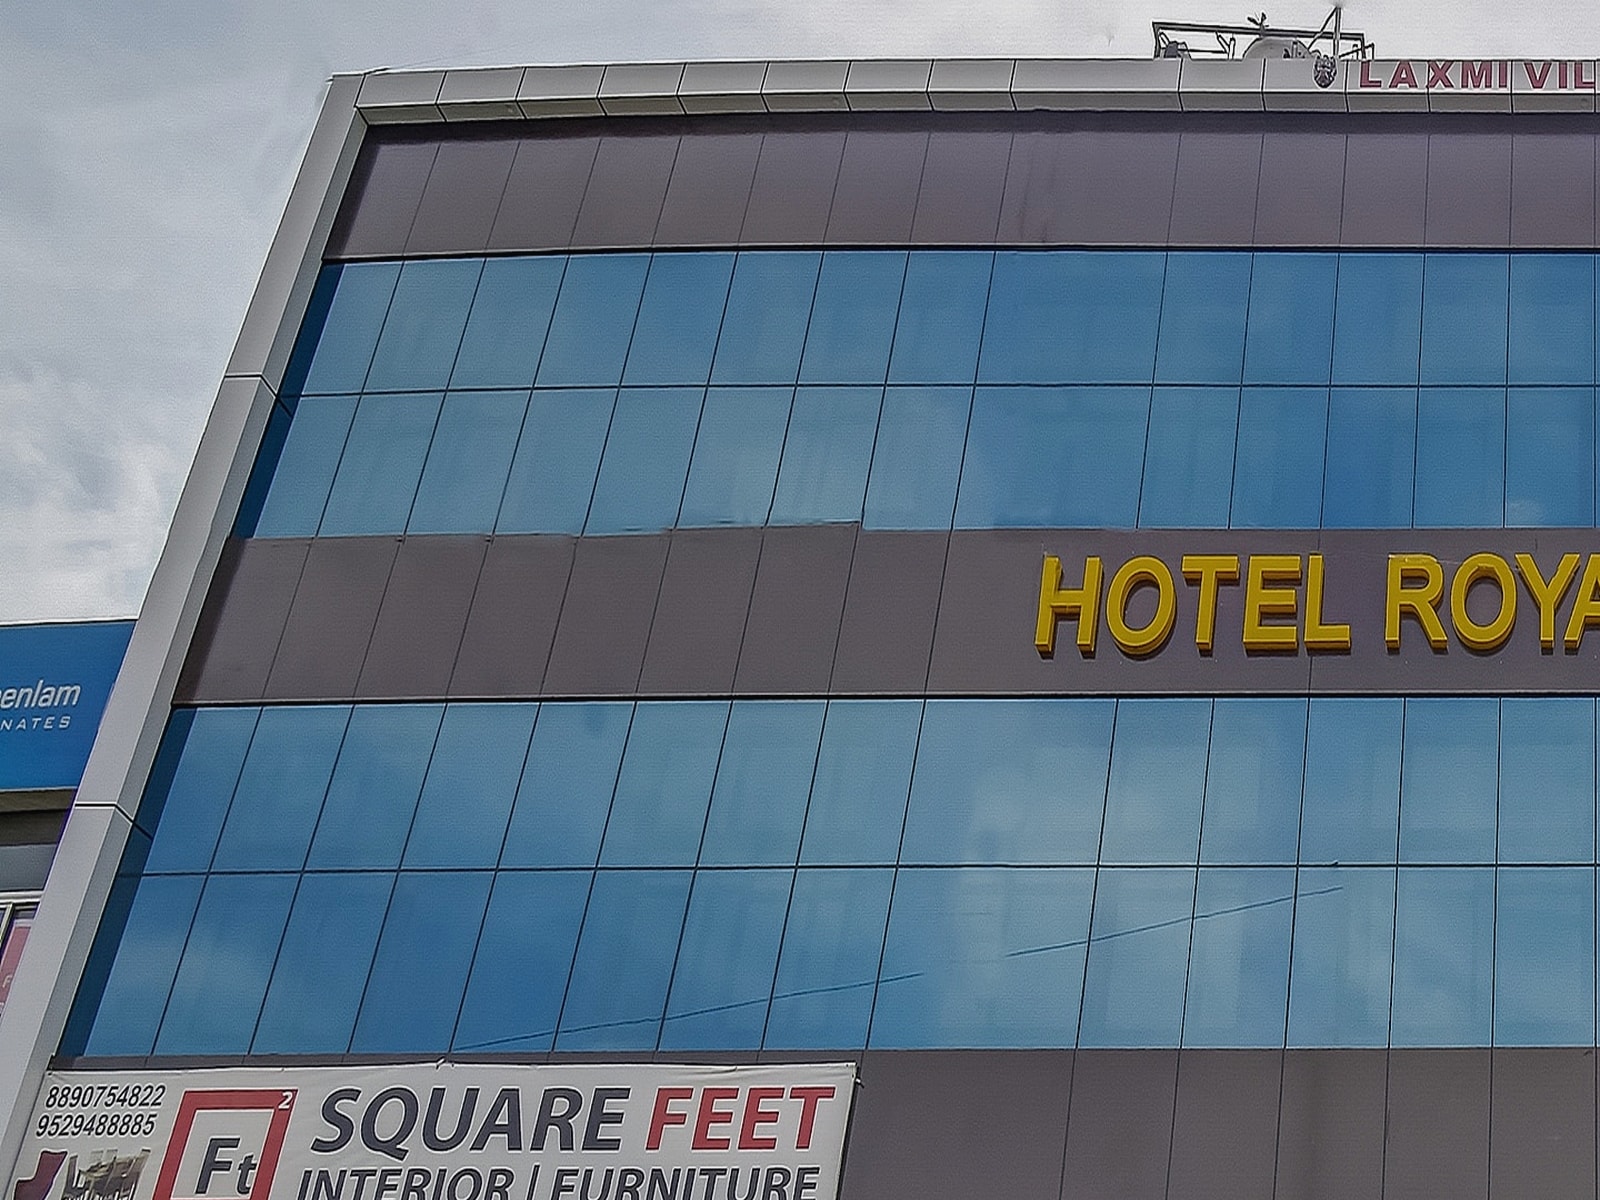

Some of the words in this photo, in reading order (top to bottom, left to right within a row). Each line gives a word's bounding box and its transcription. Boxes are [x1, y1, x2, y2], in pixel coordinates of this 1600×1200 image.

[1359, 61, 1507, 89] LAXMI
[1034, 553, 1352, 656] HOTEL
[0, 679, 81, 709] enlam
[46, 1085, 166, 1109] 8890754822
[36, 1114, 157, 1137] 9529488885
[310, 1087, 631, 1161] SQUARE
[645, 1087, 836, 1150] FEET
[195, 1137, 258, 1195] Ft
